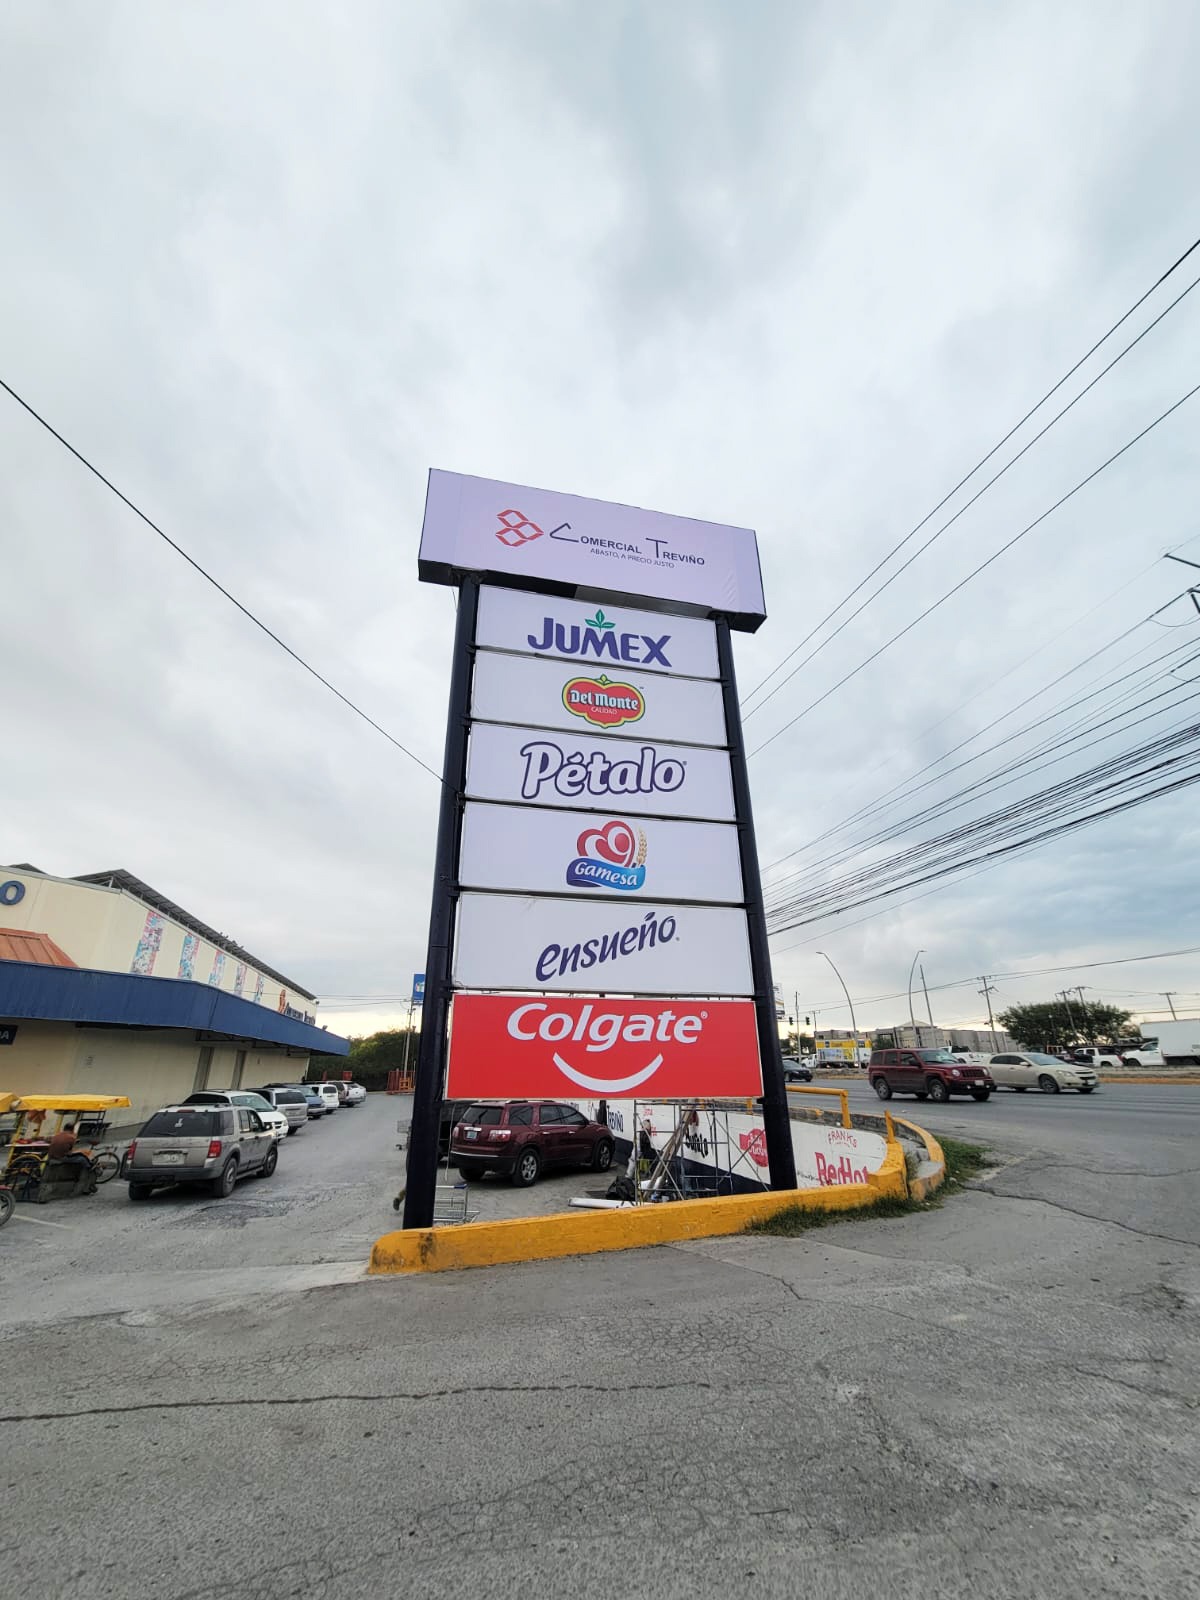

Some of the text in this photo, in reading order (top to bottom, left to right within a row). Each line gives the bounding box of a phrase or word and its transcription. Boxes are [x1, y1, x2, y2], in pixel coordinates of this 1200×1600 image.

[549, 522, 705, 566] COMERCIAL TREVIÑO
[627, 553, 653, 565] PRECIO
[653, 559, 675, 569] JUSTO
[527, 616, 672, 668] JUMEX
[570, 689, 639, 710] Del Monte
[590, 706, 618, 715] CALIDAD
[520, 741, 686, 800] Pétalo
[574, 861, 638, 886] Gamesa
[535, 911, 677, 982] ensueño
[506, 1002, 703, 1053] Colgate
